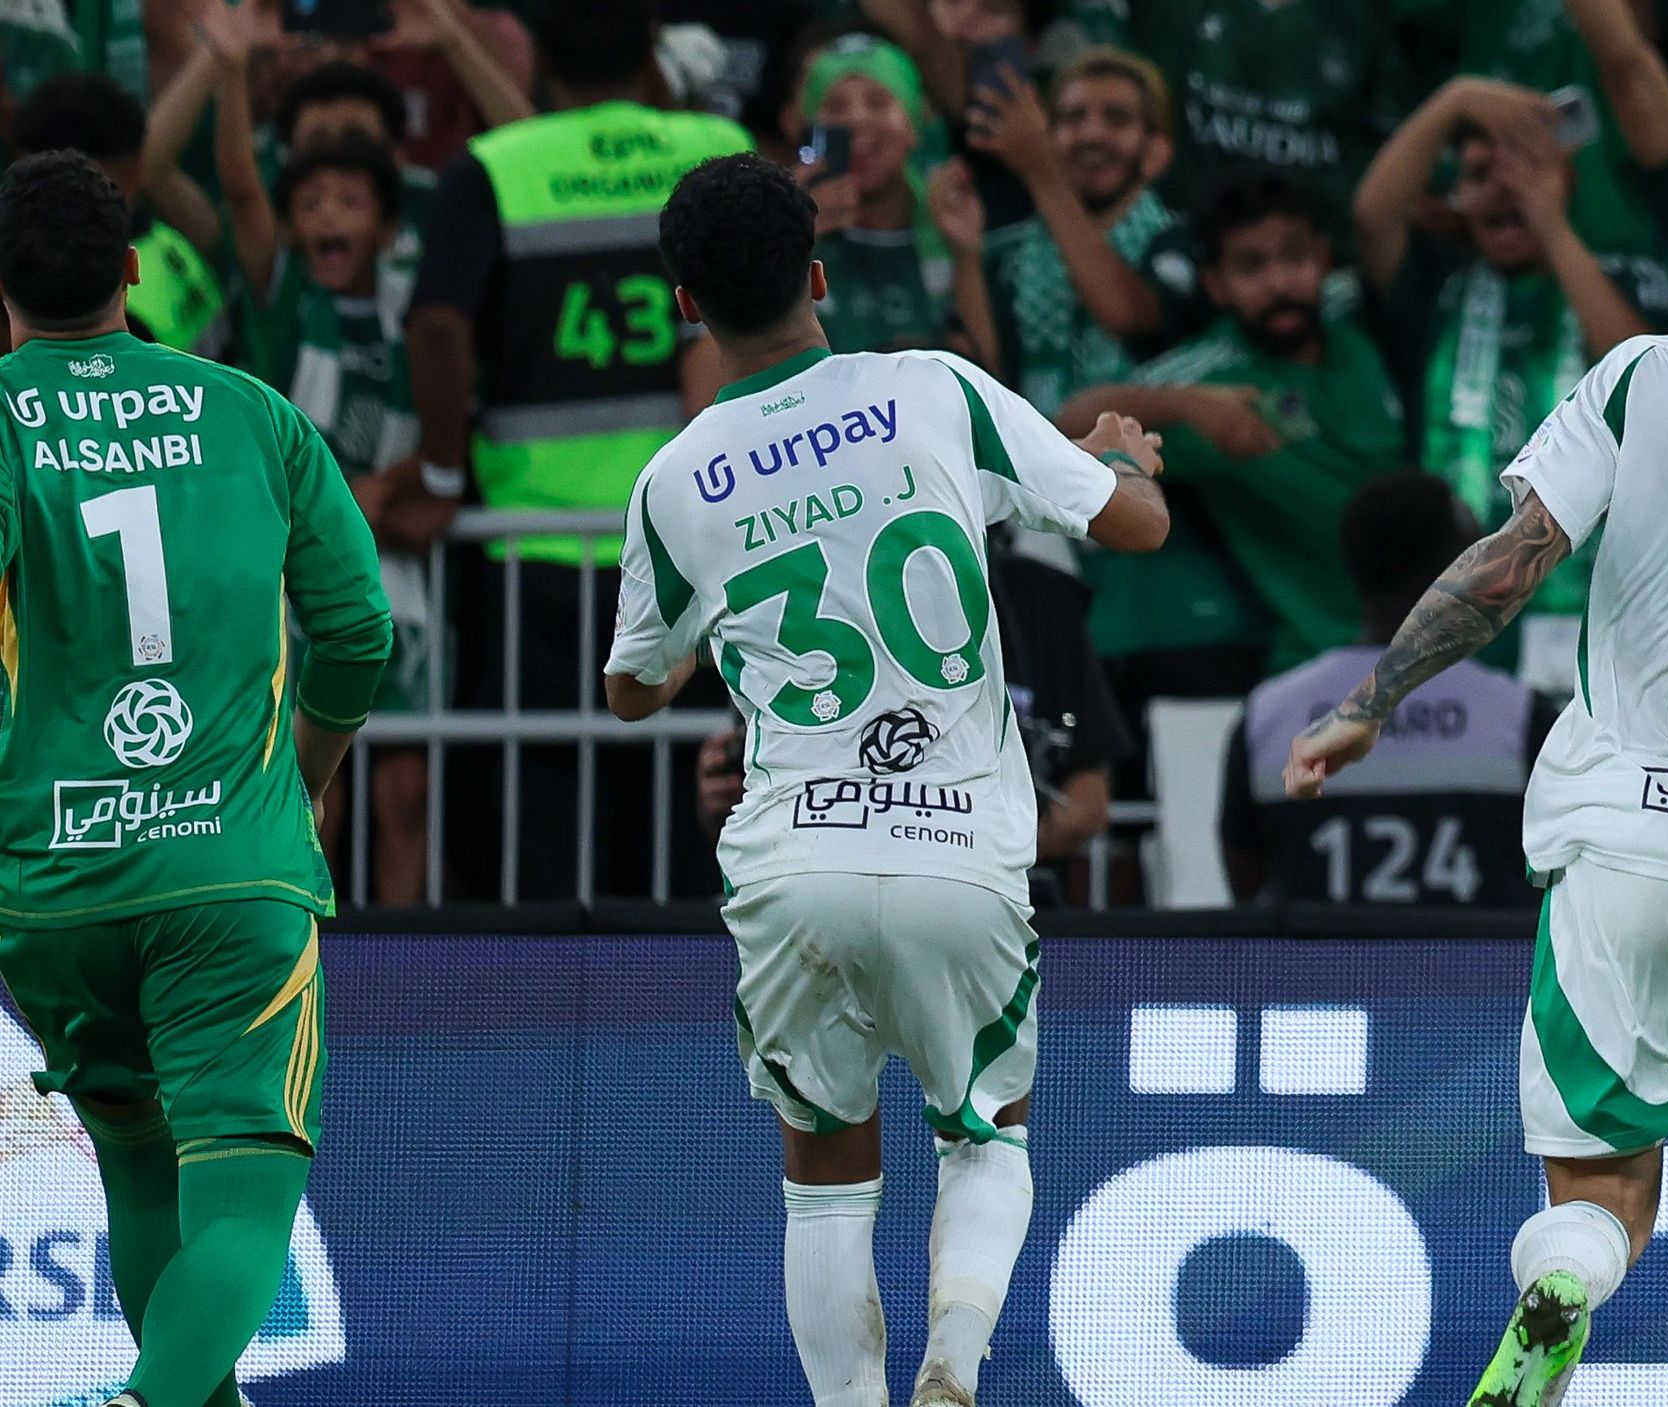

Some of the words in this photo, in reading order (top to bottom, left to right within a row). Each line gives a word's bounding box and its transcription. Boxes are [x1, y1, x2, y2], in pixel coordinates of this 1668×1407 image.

[554, 274, 677, 368] 43
[58, 384, 204, 429] urpay
[748, 399, 898, 468] urpay
[34, 434, 204, 473] ALSANBI
[734, 484, 865, 552] ZIYAD
[79, 484, 173, 667] 1
[723, 510, 990, 727] 30
[65, 780, 221, 842] سينومي
[1310, 814, 1481, 903] 124
